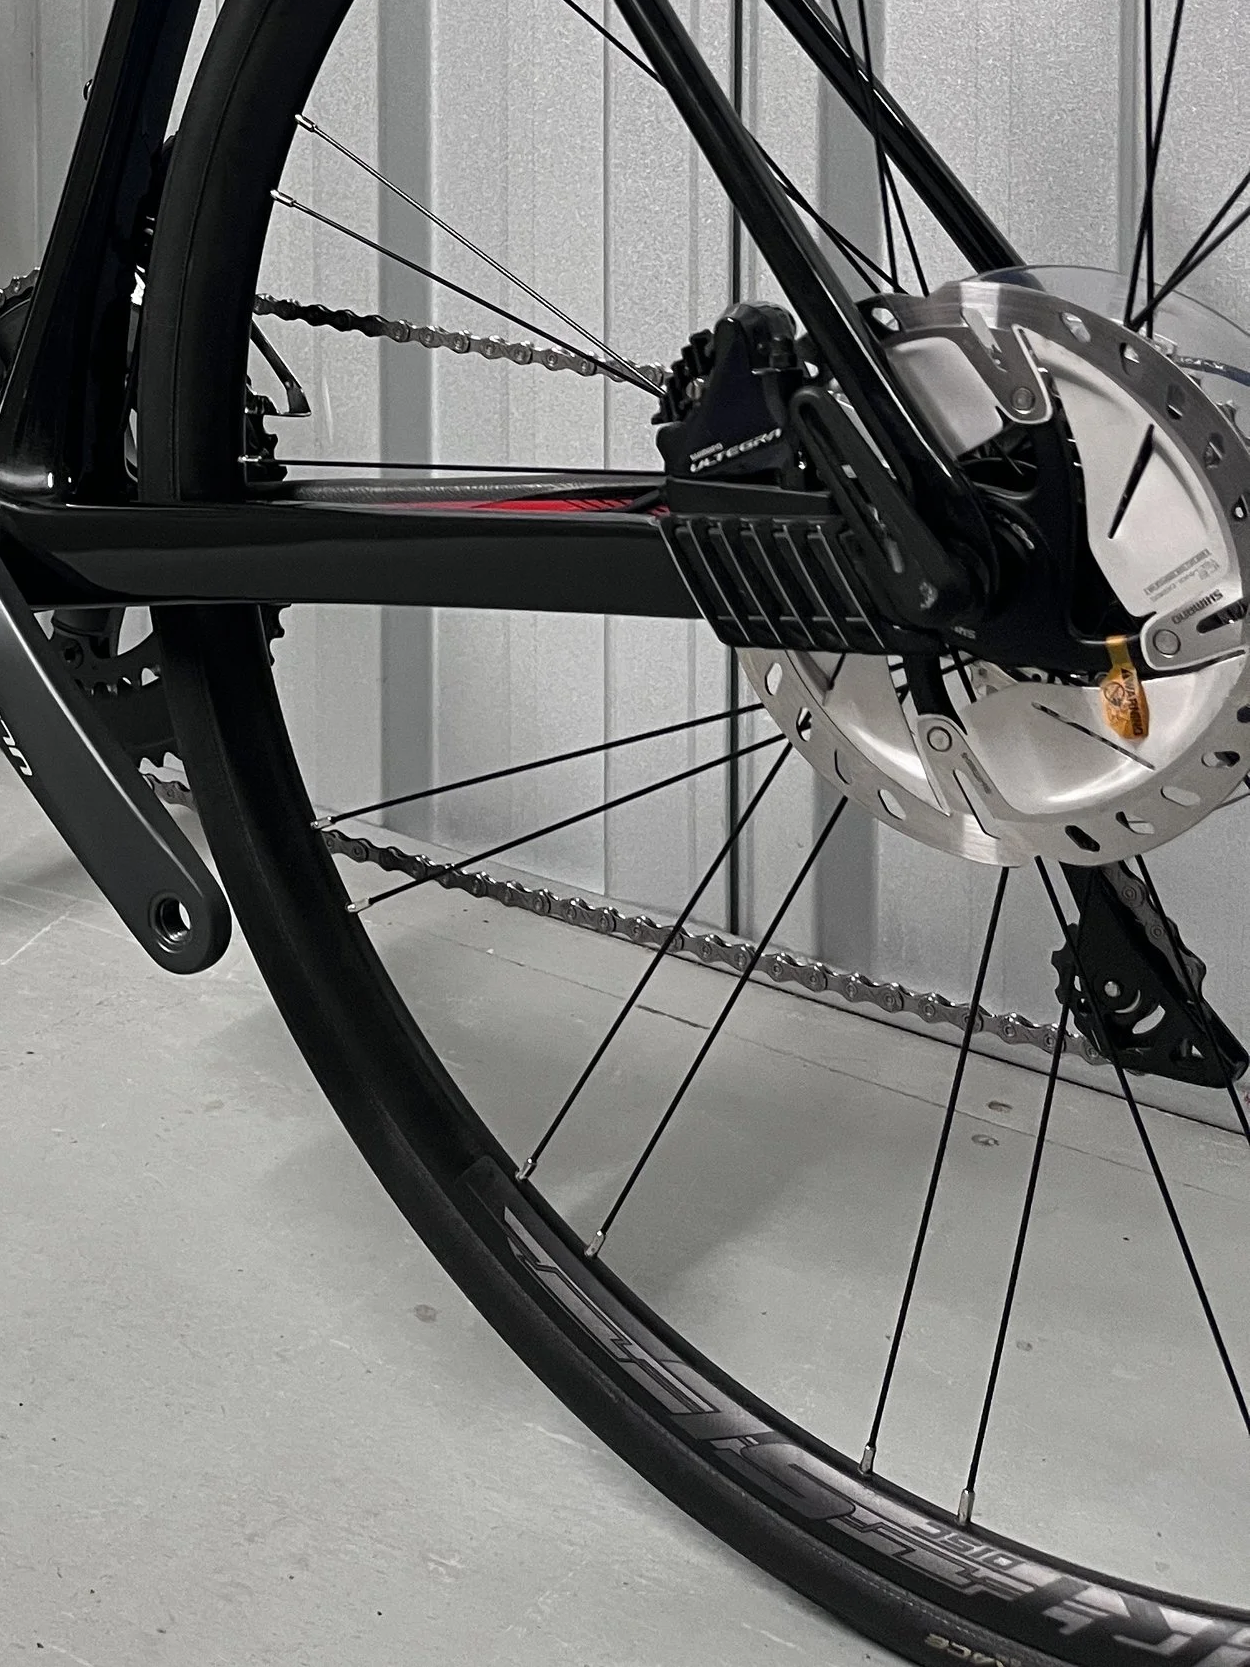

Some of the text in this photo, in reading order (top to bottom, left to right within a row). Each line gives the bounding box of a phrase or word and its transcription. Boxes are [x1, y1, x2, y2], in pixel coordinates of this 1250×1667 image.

[690, 428, 782, 472] ULTEGRA
[1171, 588, 1224, 625] SHIMANO
[1125, 678, 1144, 736] WARNING
[908, 1520, 1025, 1571] DISC
